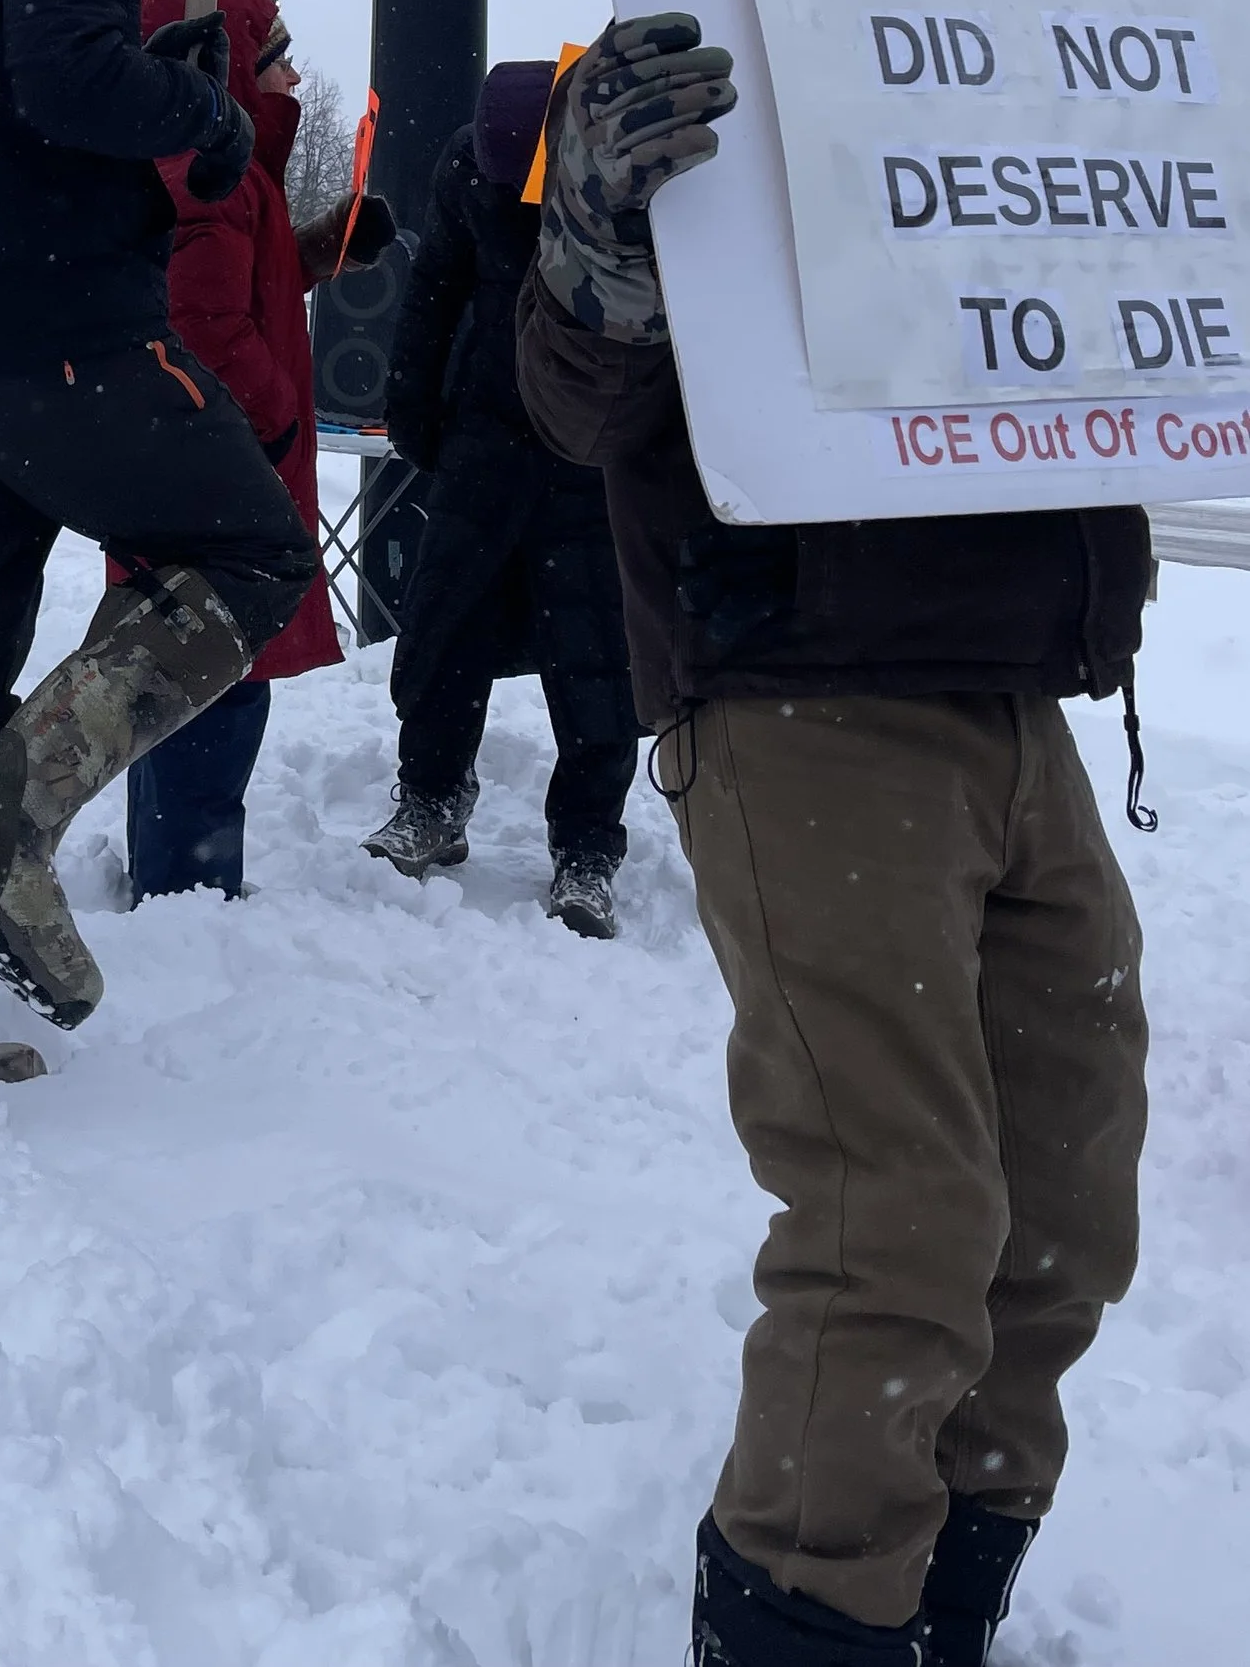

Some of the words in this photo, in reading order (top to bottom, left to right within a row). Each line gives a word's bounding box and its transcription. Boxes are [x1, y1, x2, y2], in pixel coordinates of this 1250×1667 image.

[869, 16, 996, 86] DID
[1052, 25, 1196, 94] NOT
[883, 156, 1226, 229] DESERVE
[960, 297, 1066, 371] TO
[1119, 297, 1240, 369] DIE
[891, 414, 980, 466] ICE
[990, 412, 1076, 462] Out
[1085, 408, 1137, 458] Of
